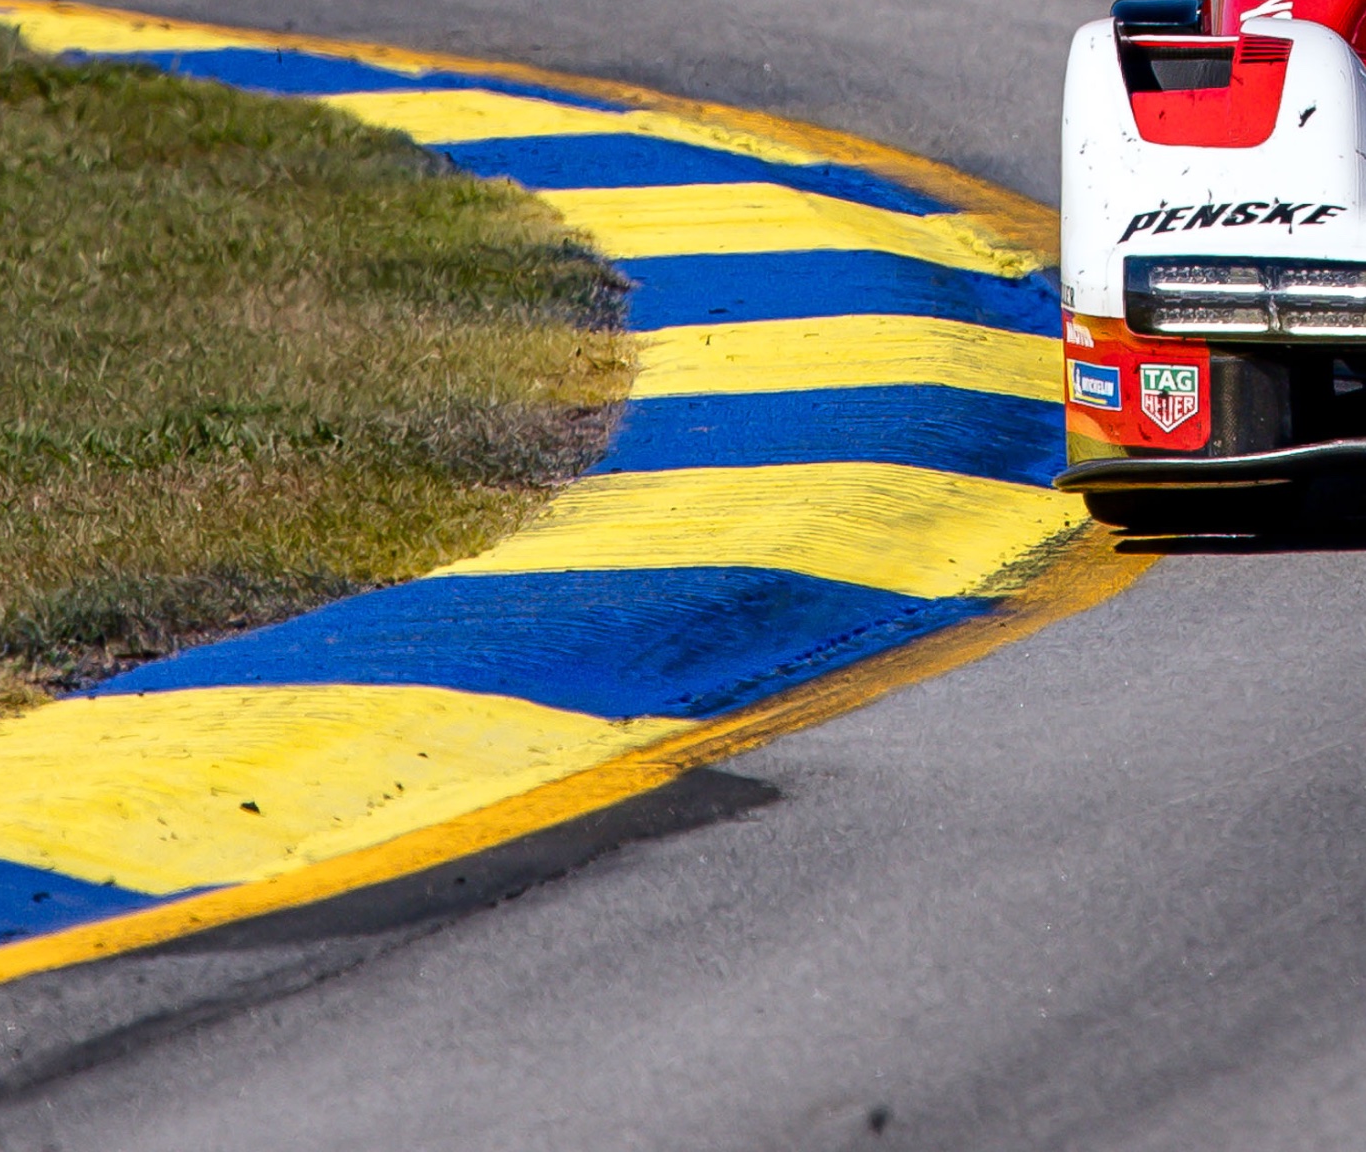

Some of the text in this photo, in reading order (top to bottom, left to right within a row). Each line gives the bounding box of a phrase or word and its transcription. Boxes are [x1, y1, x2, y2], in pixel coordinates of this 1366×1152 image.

[1117, 202, 1347, 244] PENSKE
[1145, 370, 1193, 391] TAG
[1144, 394, 1194, 426] HEUER
